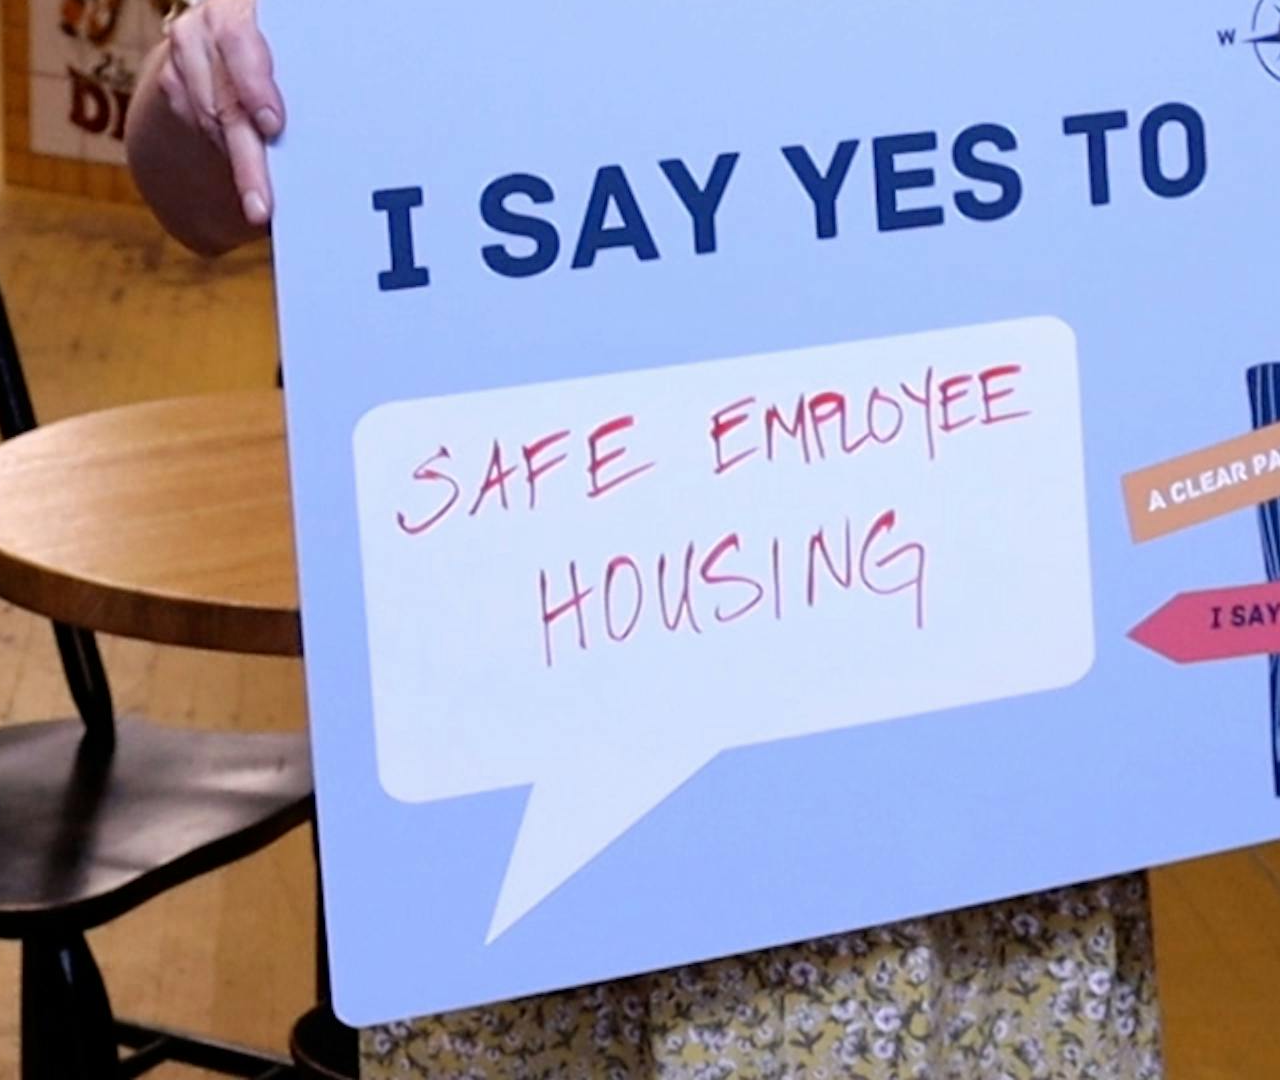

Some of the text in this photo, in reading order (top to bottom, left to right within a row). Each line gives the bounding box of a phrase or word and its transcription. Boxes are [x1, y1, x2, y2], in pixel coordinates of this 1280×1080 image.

[1216, 28, 1236, 47] W
[372, 101, 1208, 292] I SAY YES TO
[397, 364, 1032, 535] SAFE EMPLOYEE
[1147, 488, 1167, 513] A
[1169, 460, 1249, 504] CLEAR
[538, 509, 925, 668] HOUSING
[1211, 606, 1223, 630] I
